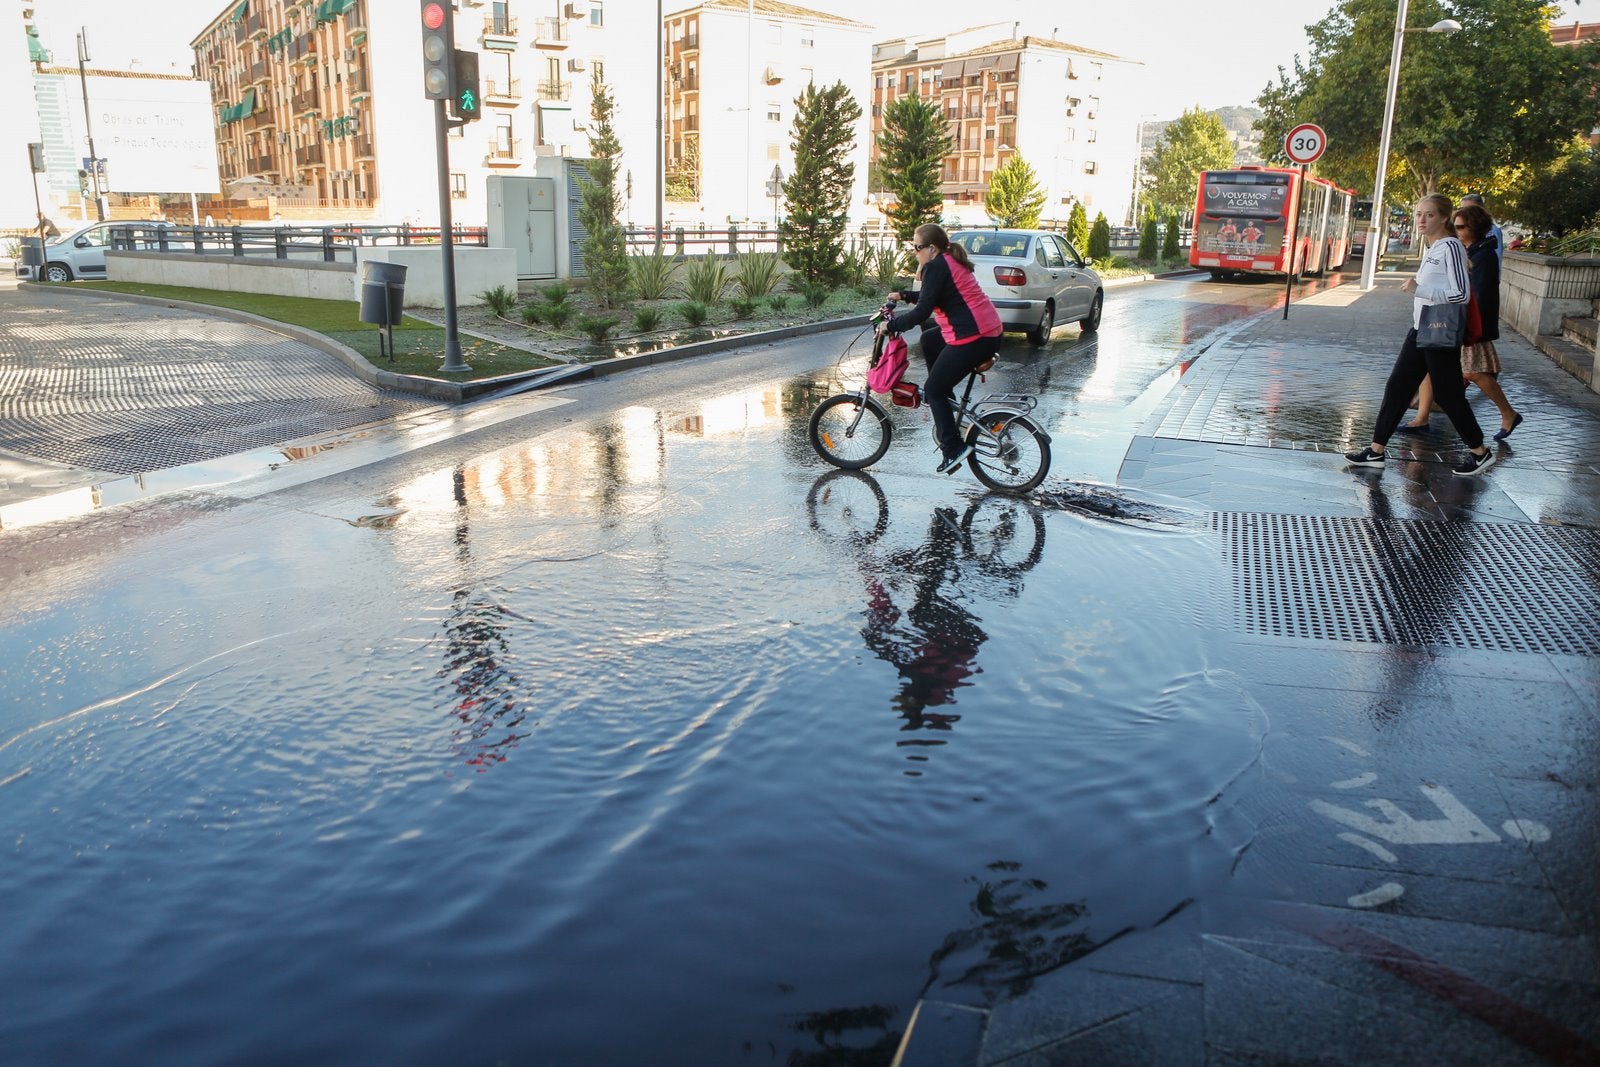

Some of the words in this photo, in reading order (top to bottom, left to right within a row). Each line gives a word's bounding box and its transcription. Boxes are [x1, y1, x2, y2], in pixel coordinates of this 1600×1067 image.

[1294, 138, 1317, 151] 30
[1222, 191, 1267, 200] VOLVEMOS
[1236, 199, 1259, 207] CASA
